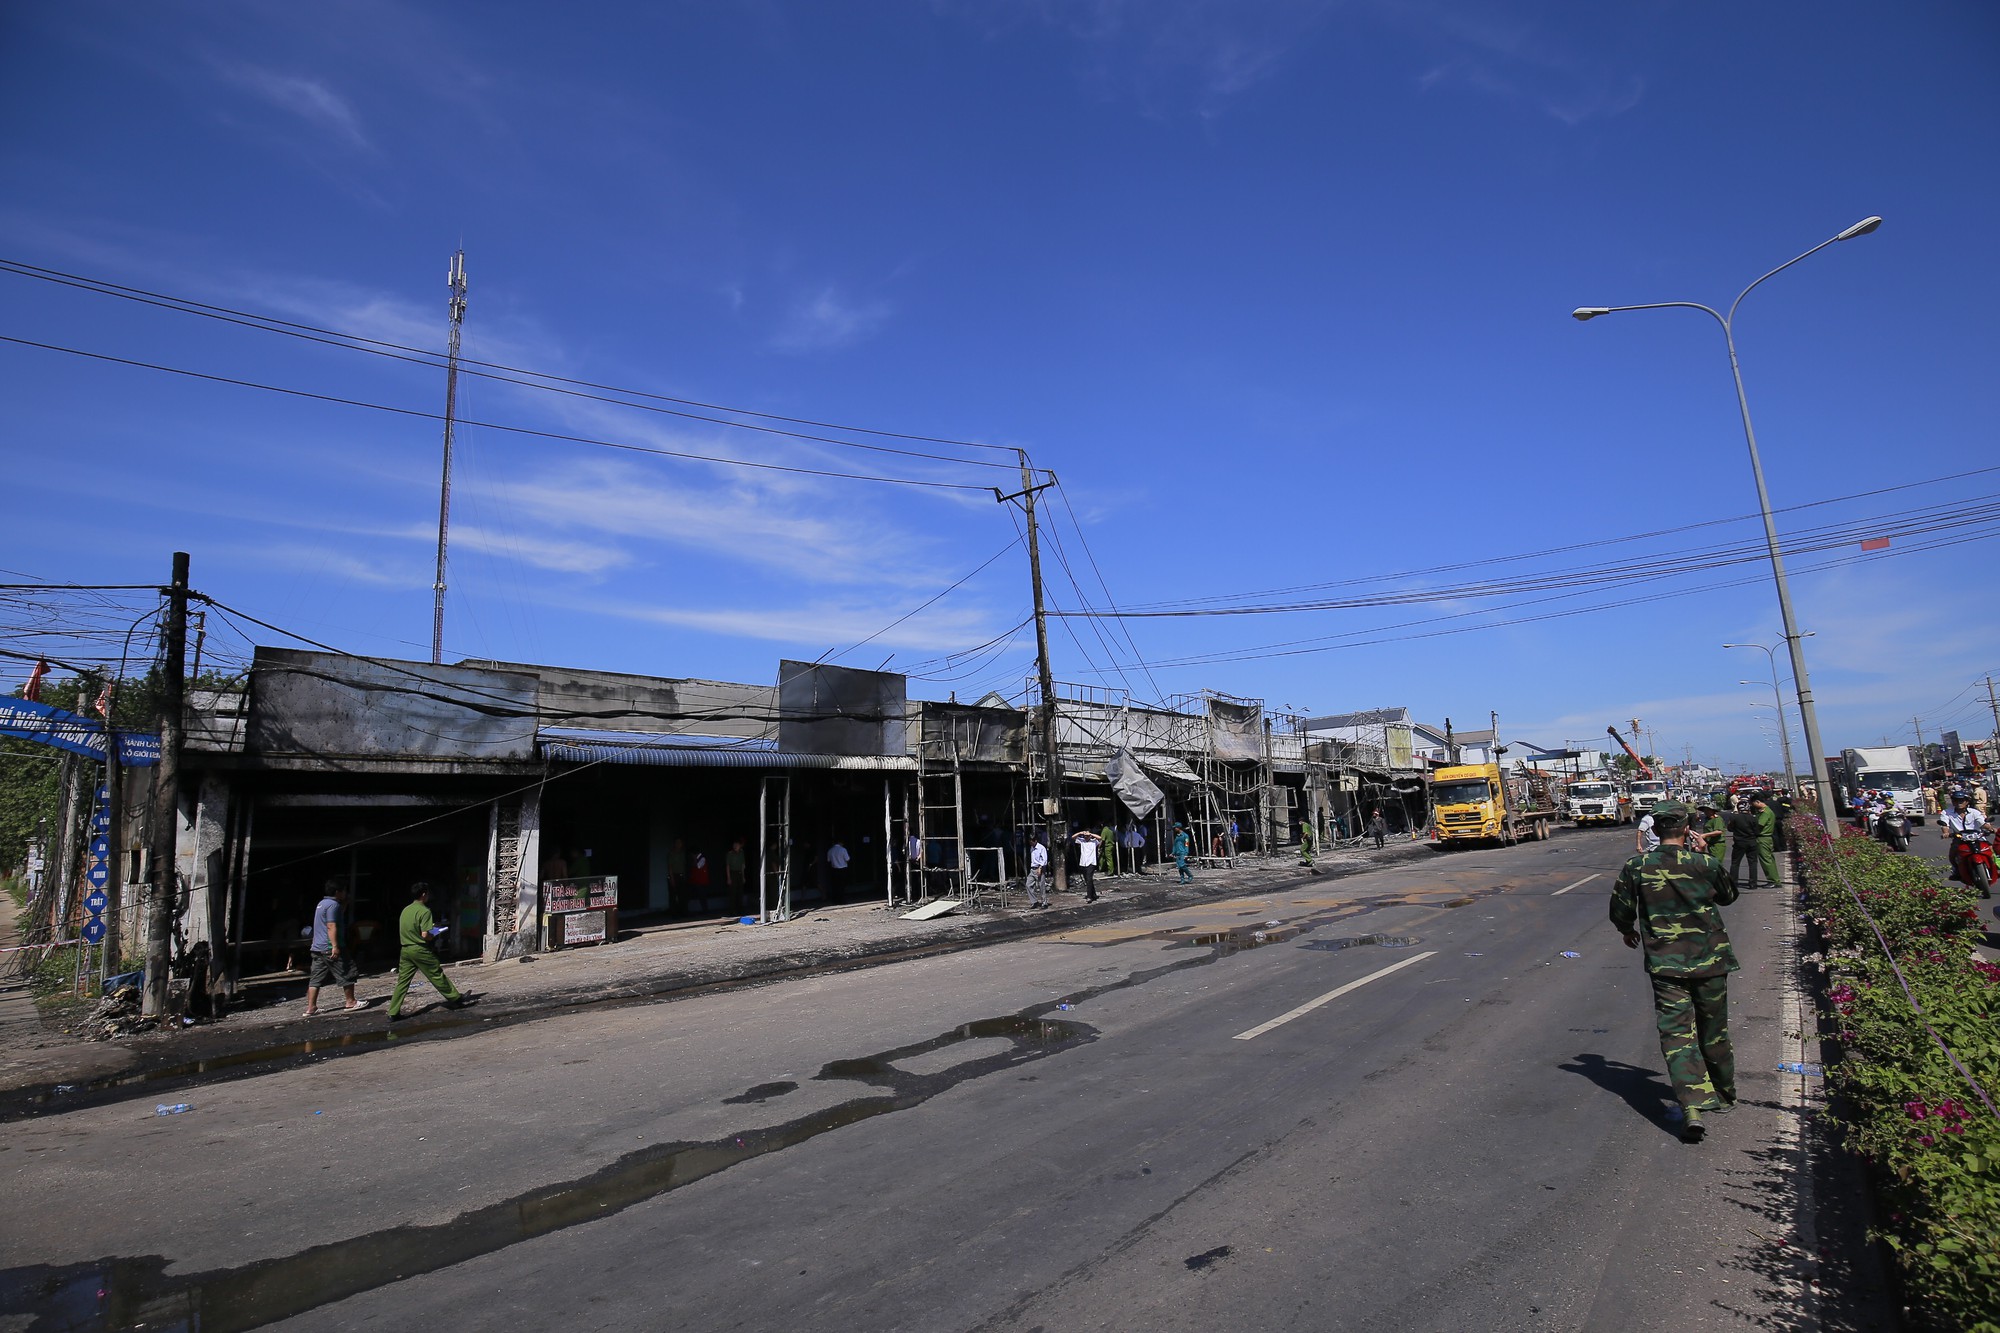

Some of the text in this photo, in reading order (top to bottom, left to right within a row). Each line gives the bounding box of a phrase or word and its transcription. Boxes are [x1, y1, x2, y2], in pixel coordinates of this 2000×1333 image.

[98, 843, 106, 851] AN
[552, 884, 565, 898] TRÀ
[90, 897, 103, 907] TRẬT
[552, 898, 570, 911] BÁNH
